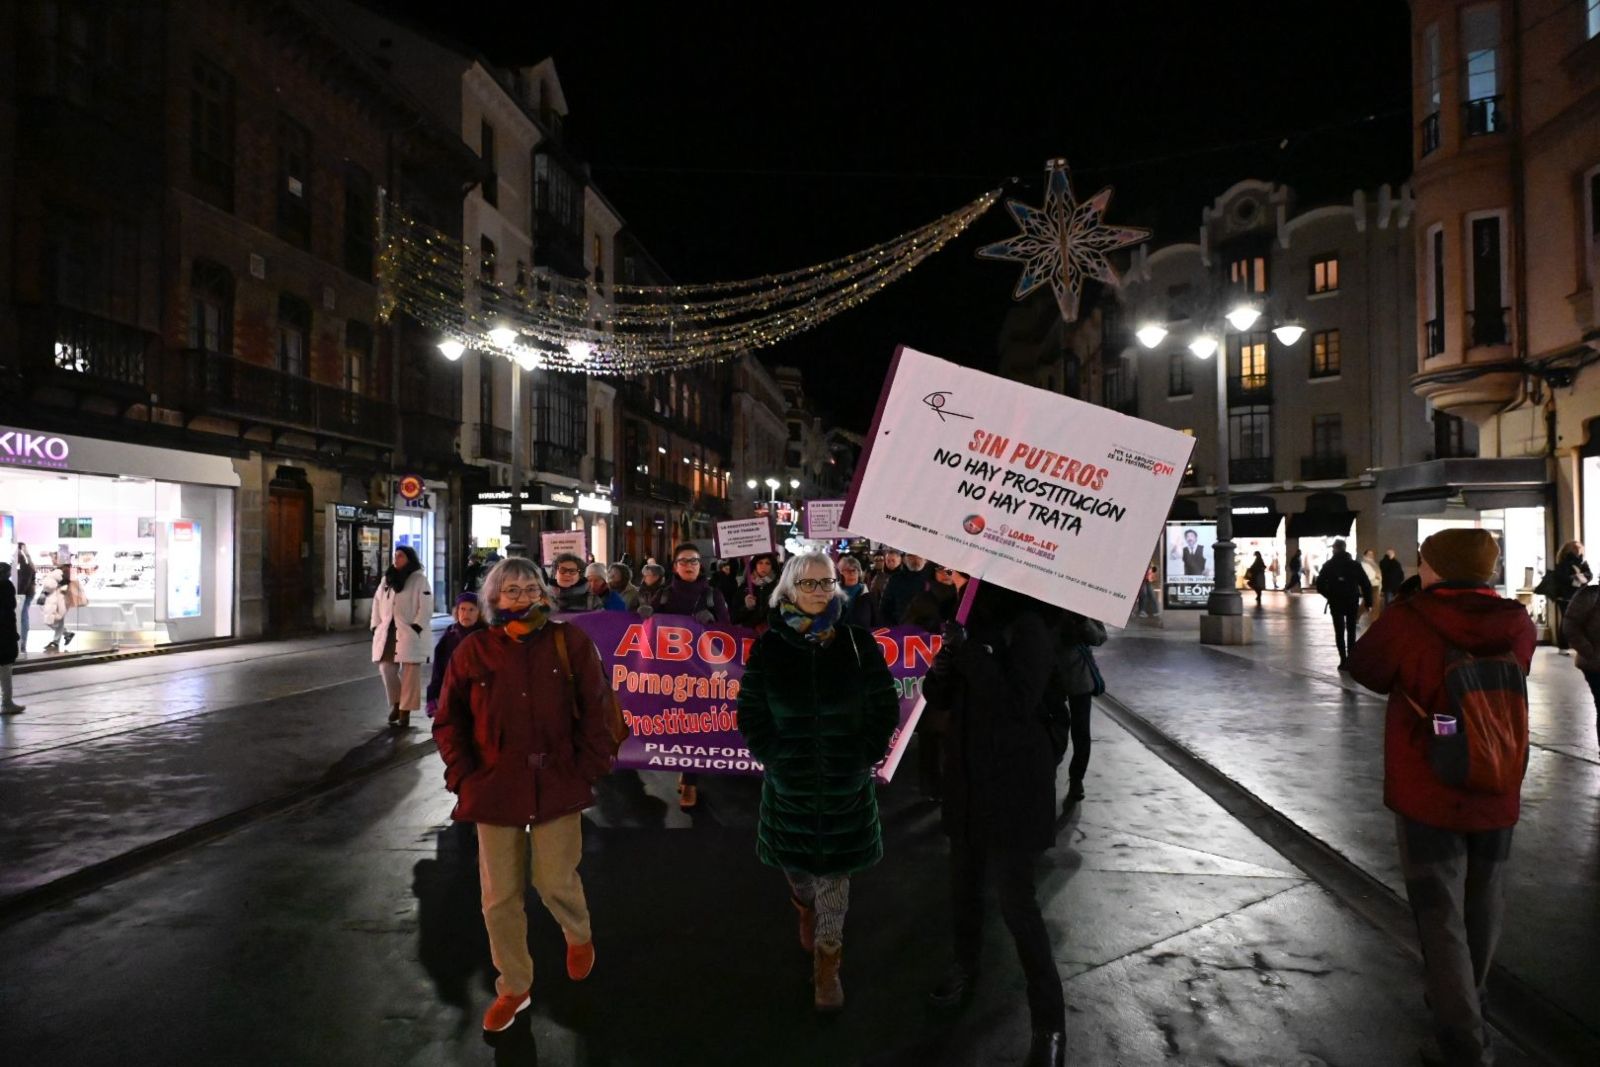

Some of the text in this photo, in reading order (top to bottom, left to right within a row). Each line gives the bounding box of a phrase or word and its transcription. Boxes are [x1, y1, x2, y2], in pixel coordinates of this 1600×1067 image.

[0, 432, 69, 460] KIKO
[968, 429, 1010, 459] SIN
[1009, 443, 1109, 491] PUTEROS
[934, 448, 1126, 522] NO HAY PROSTITUCIÓN
[957, 480, 1082, 536] NO HAY TRATA
[612, 664, 740, 703] Pornografía
